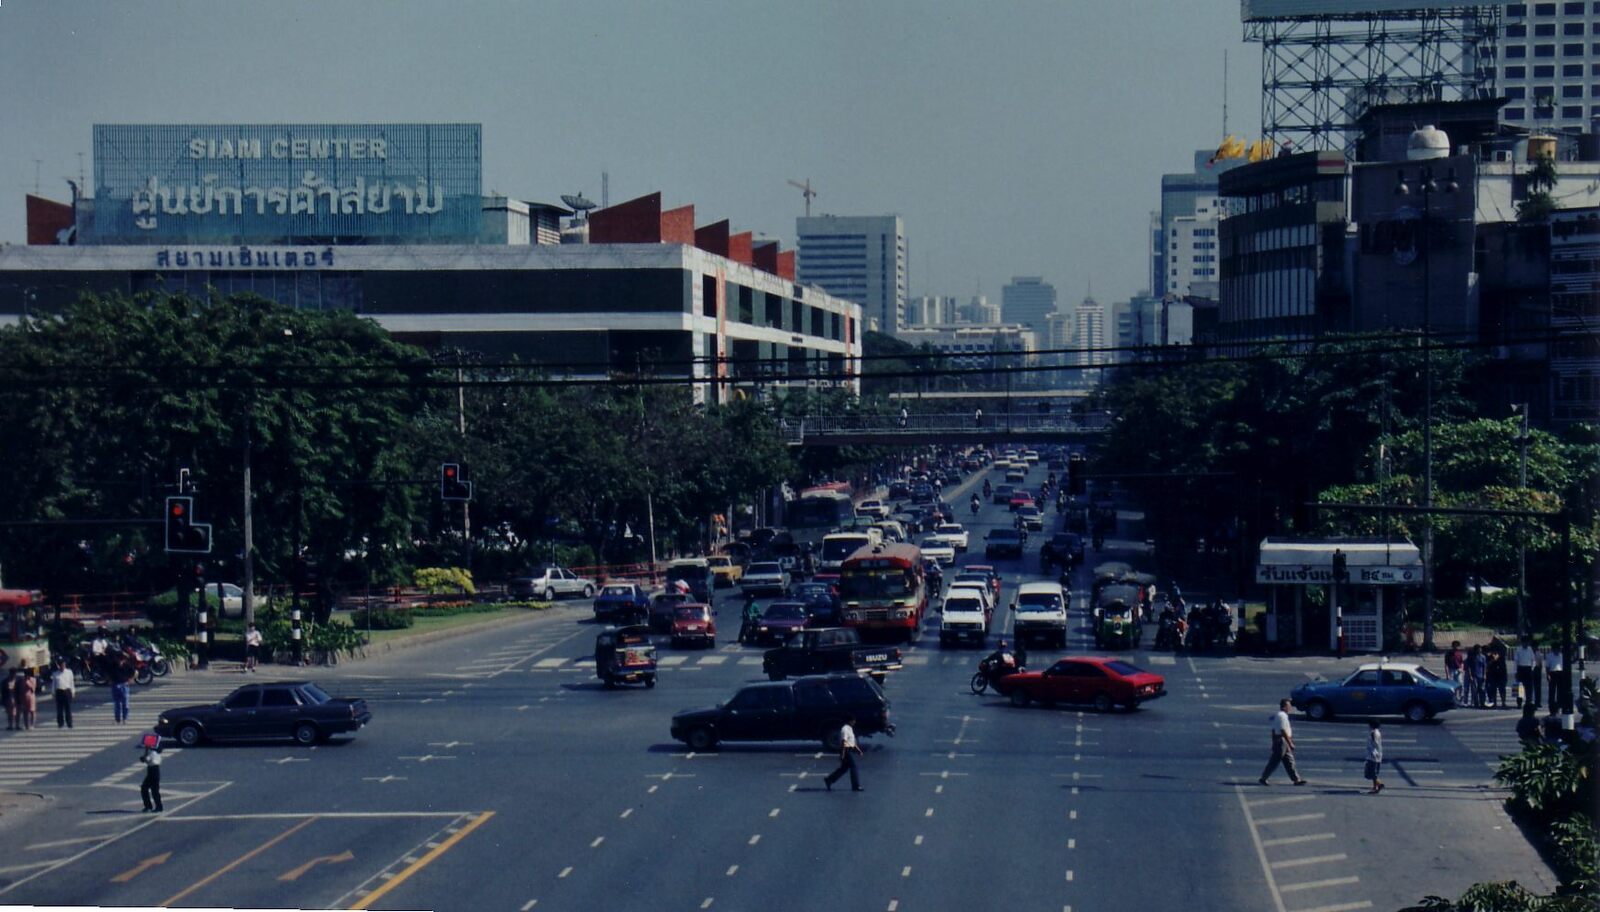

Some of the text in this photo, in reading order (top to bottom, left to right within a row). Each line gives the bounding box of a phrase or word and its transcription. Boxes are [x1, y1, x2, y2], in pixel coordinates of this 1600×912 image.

[189, 138, 387, 159] SIAM CENTER
[865, 654, 888, 662] ISUZU
